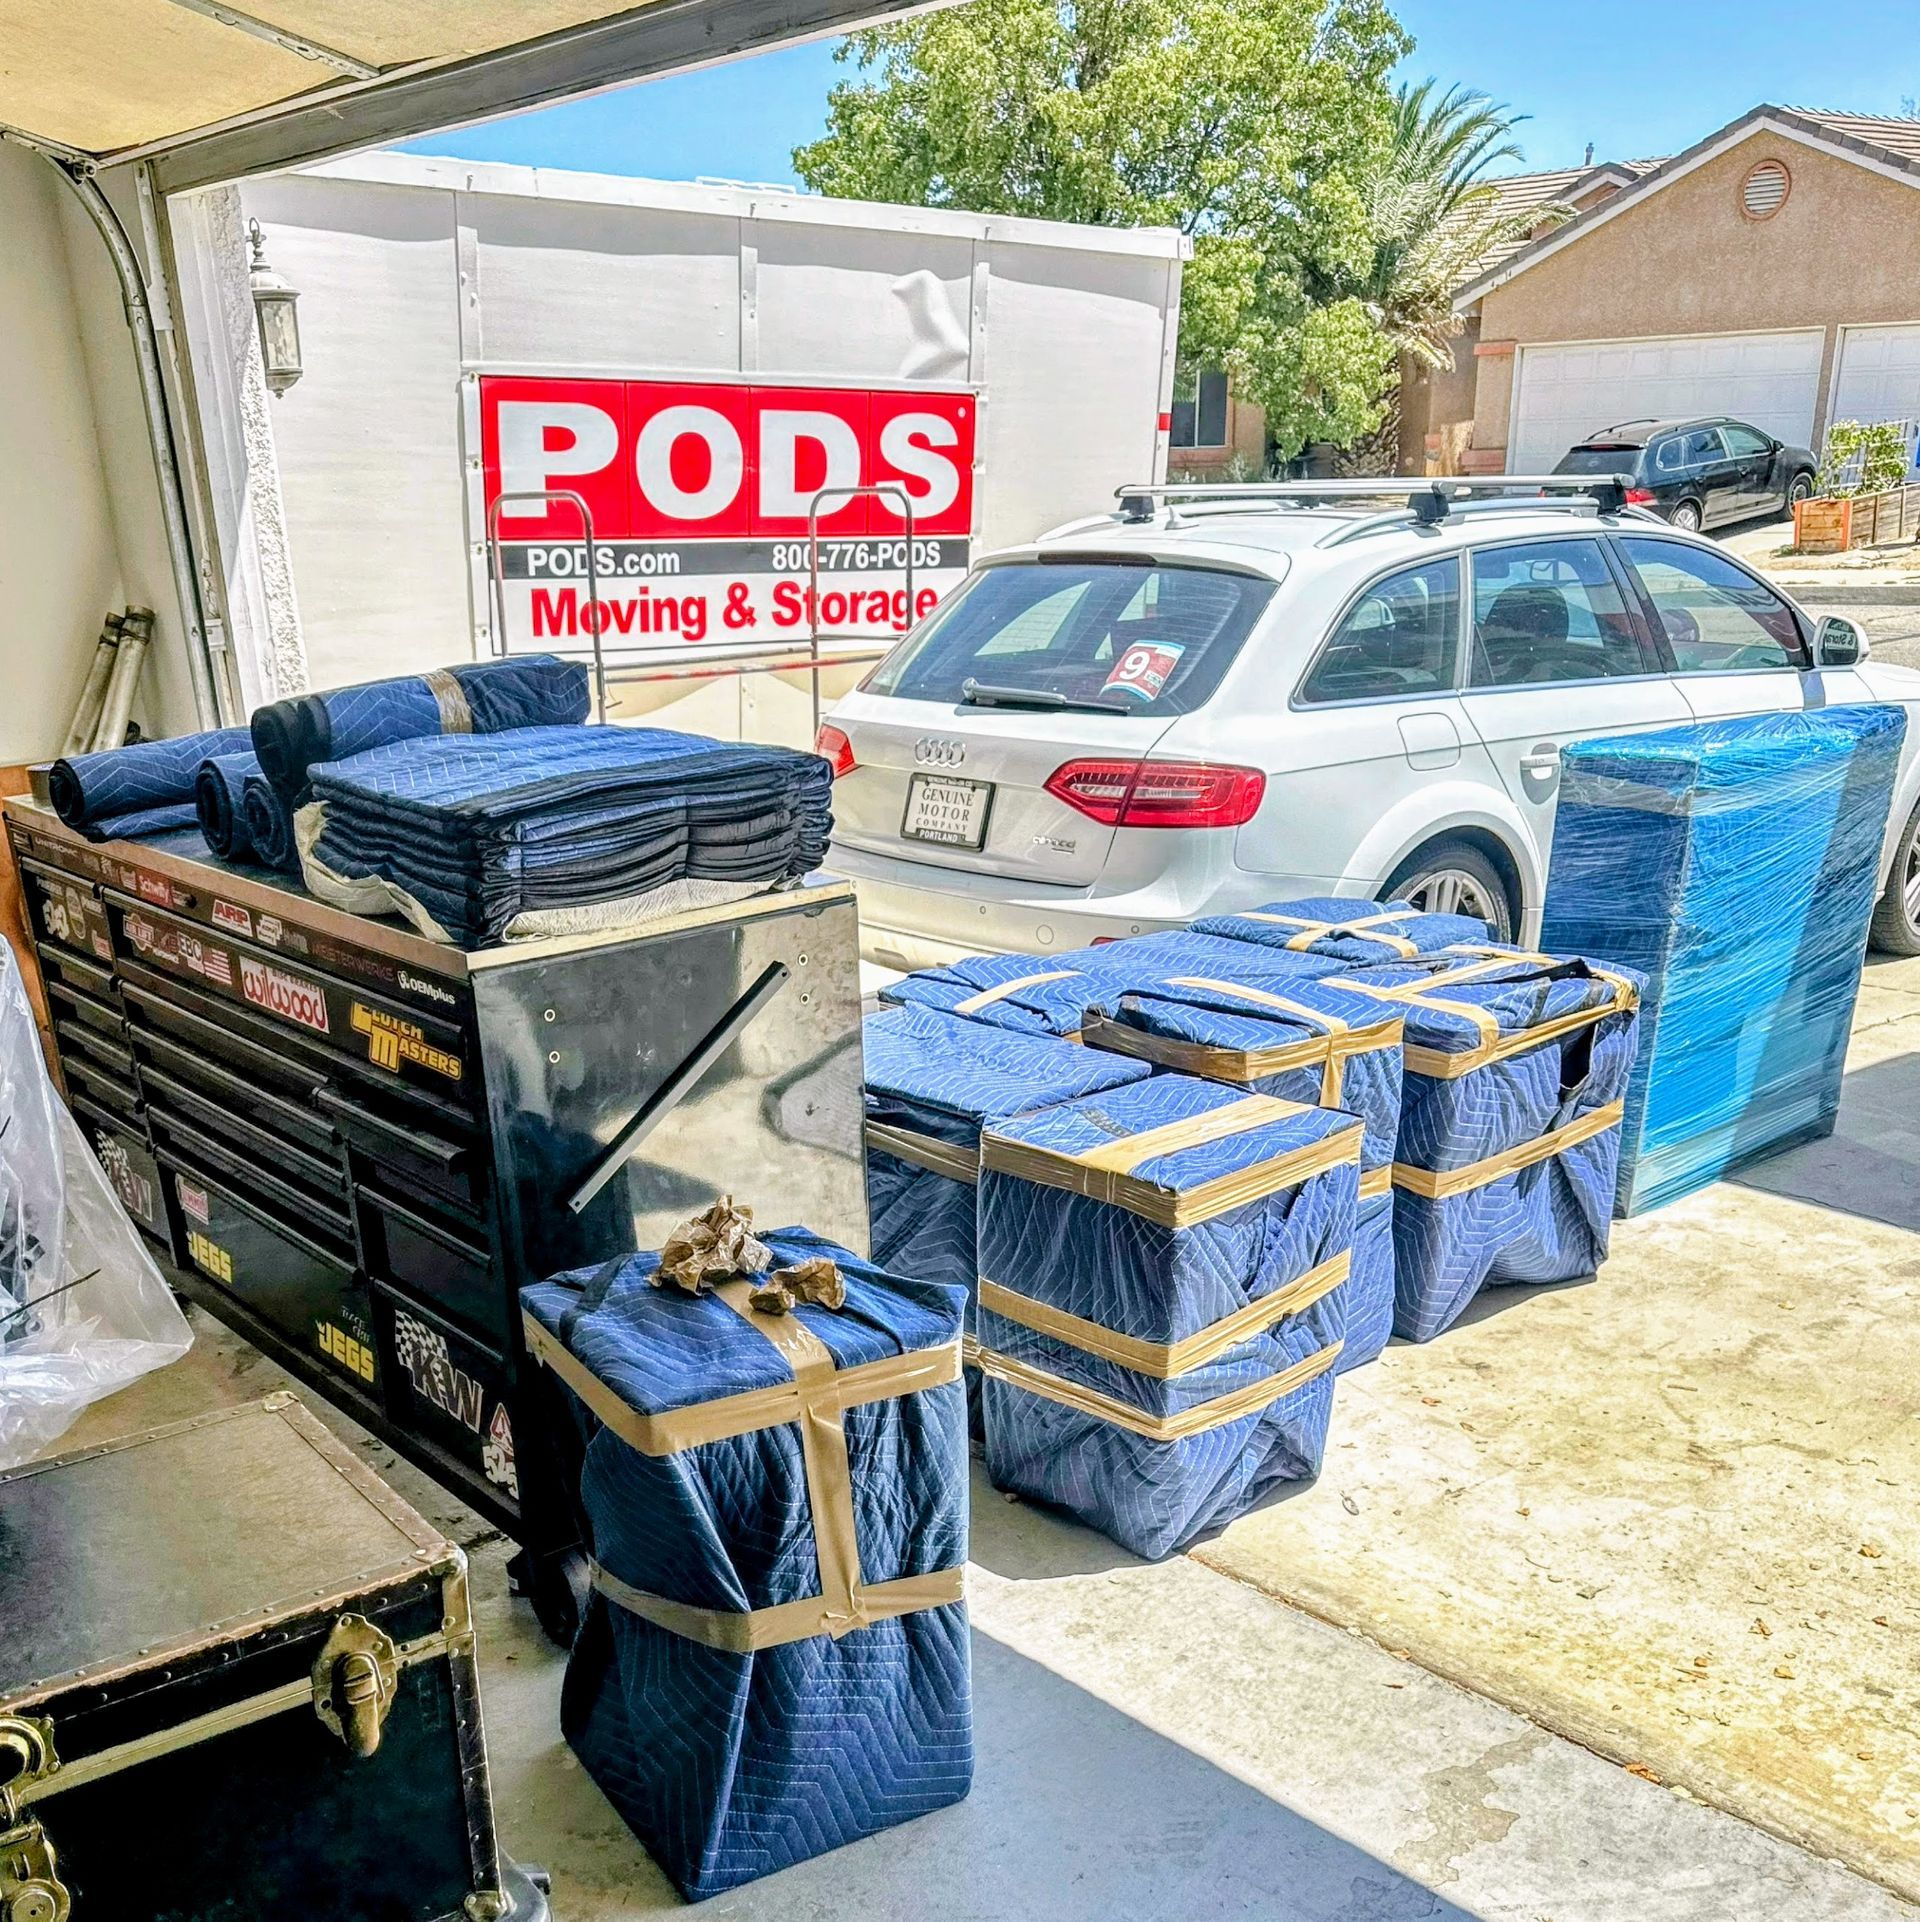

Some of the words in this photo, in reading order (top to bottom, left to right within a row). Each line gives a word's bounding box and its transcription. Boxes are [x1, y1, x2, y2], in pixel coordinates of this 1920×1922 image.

[497, 400, 960, 520] PODS
[527, 547, 680, 576] PODS.com
[772, 541, 941, 570] 800-776-PODS
[531, 586, 707, 641] Moving
[722, 581, 756, 629] &
[772, 581, 938, 631] Storage
[1119, 651, 1151, 680] 9
[919, 803, 970, 821] MOTOR
[922, 788, 975, 806] GENUINE
[916, 818, 968, 832] COMPANY
[919, 830, 958, 843] PORTLAND
[178, 932, 202, 962] EBC
[243, 964, 326, 1029] wilwood
[352, 1001, 423, 1042] CLUTCH
[370, 1026, 461, 1080] MASTERS
[187, 1231, 232, 1284] JEGS
[316, 1320, 374, 1384] JEGS
